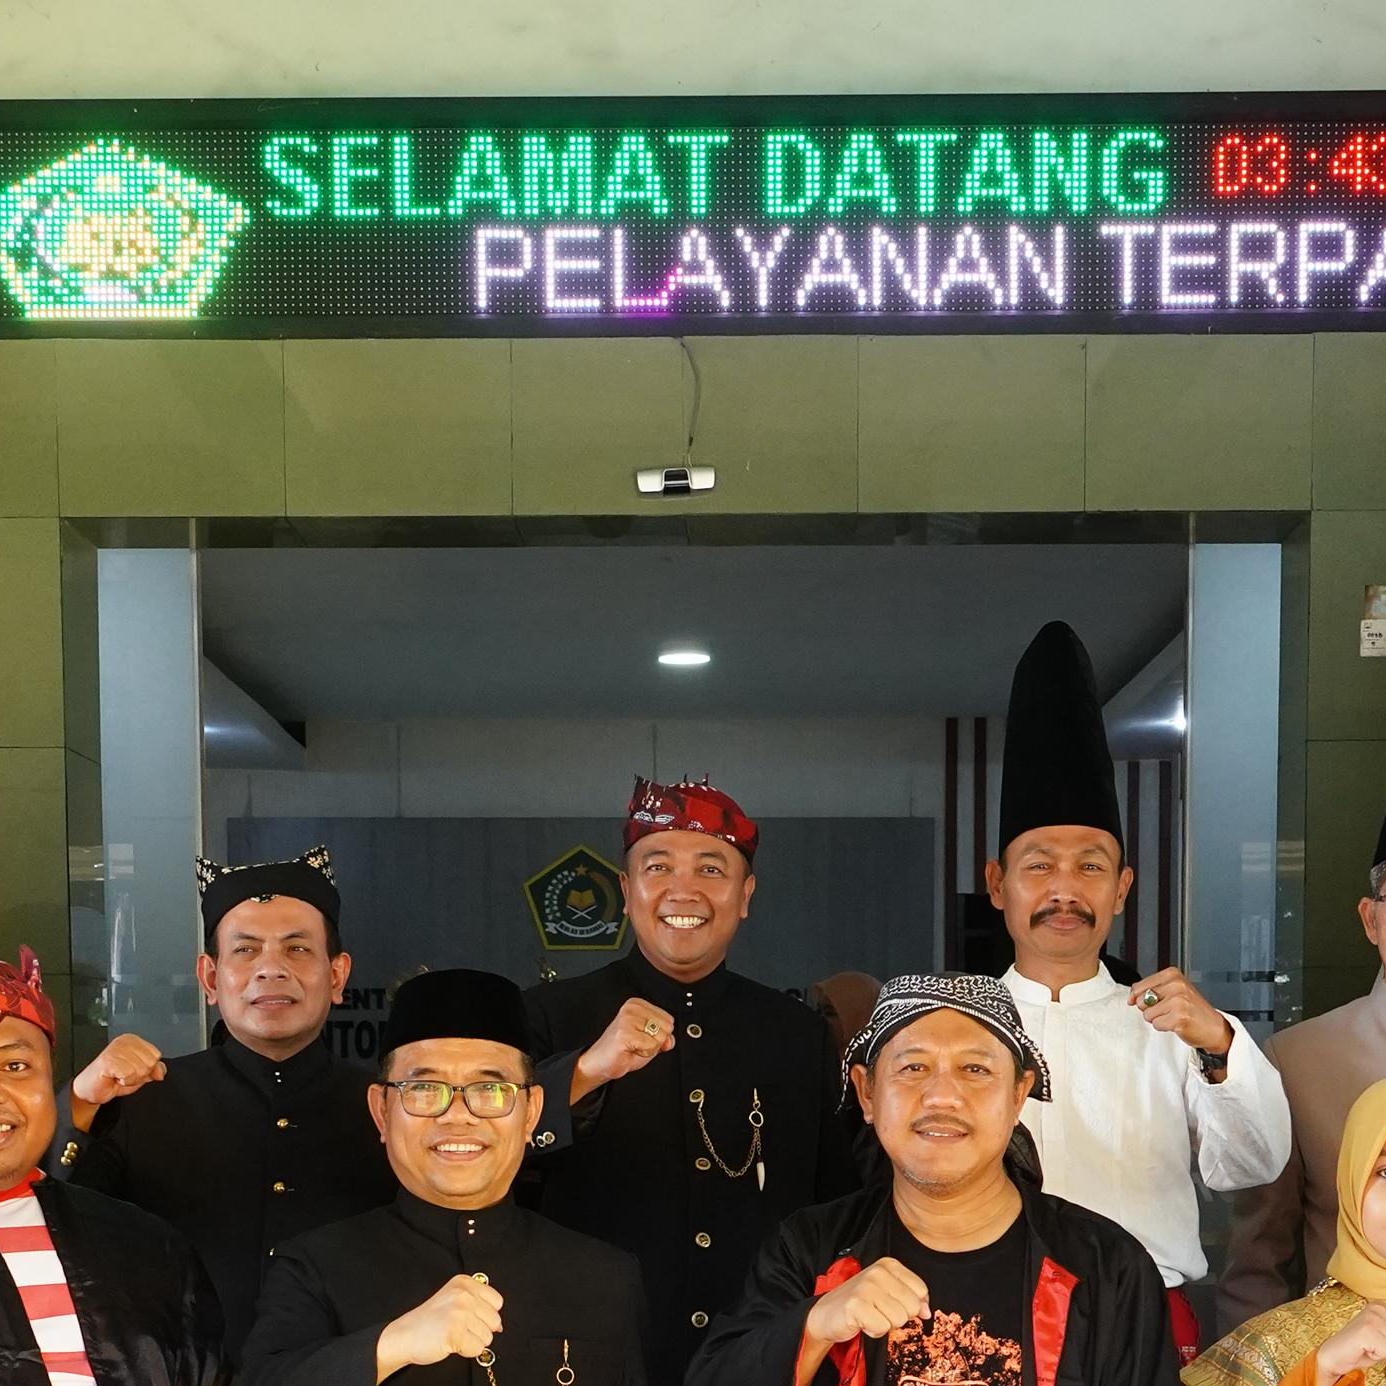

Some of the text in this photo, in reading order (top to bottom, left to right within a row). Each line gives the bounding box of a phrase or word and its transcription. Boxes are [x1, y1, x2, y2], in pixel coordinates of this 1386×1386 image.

[264, 131, 1167, 216] SELAMAT DATANG
[476, 223, 1067, 310] PELAYANAN
